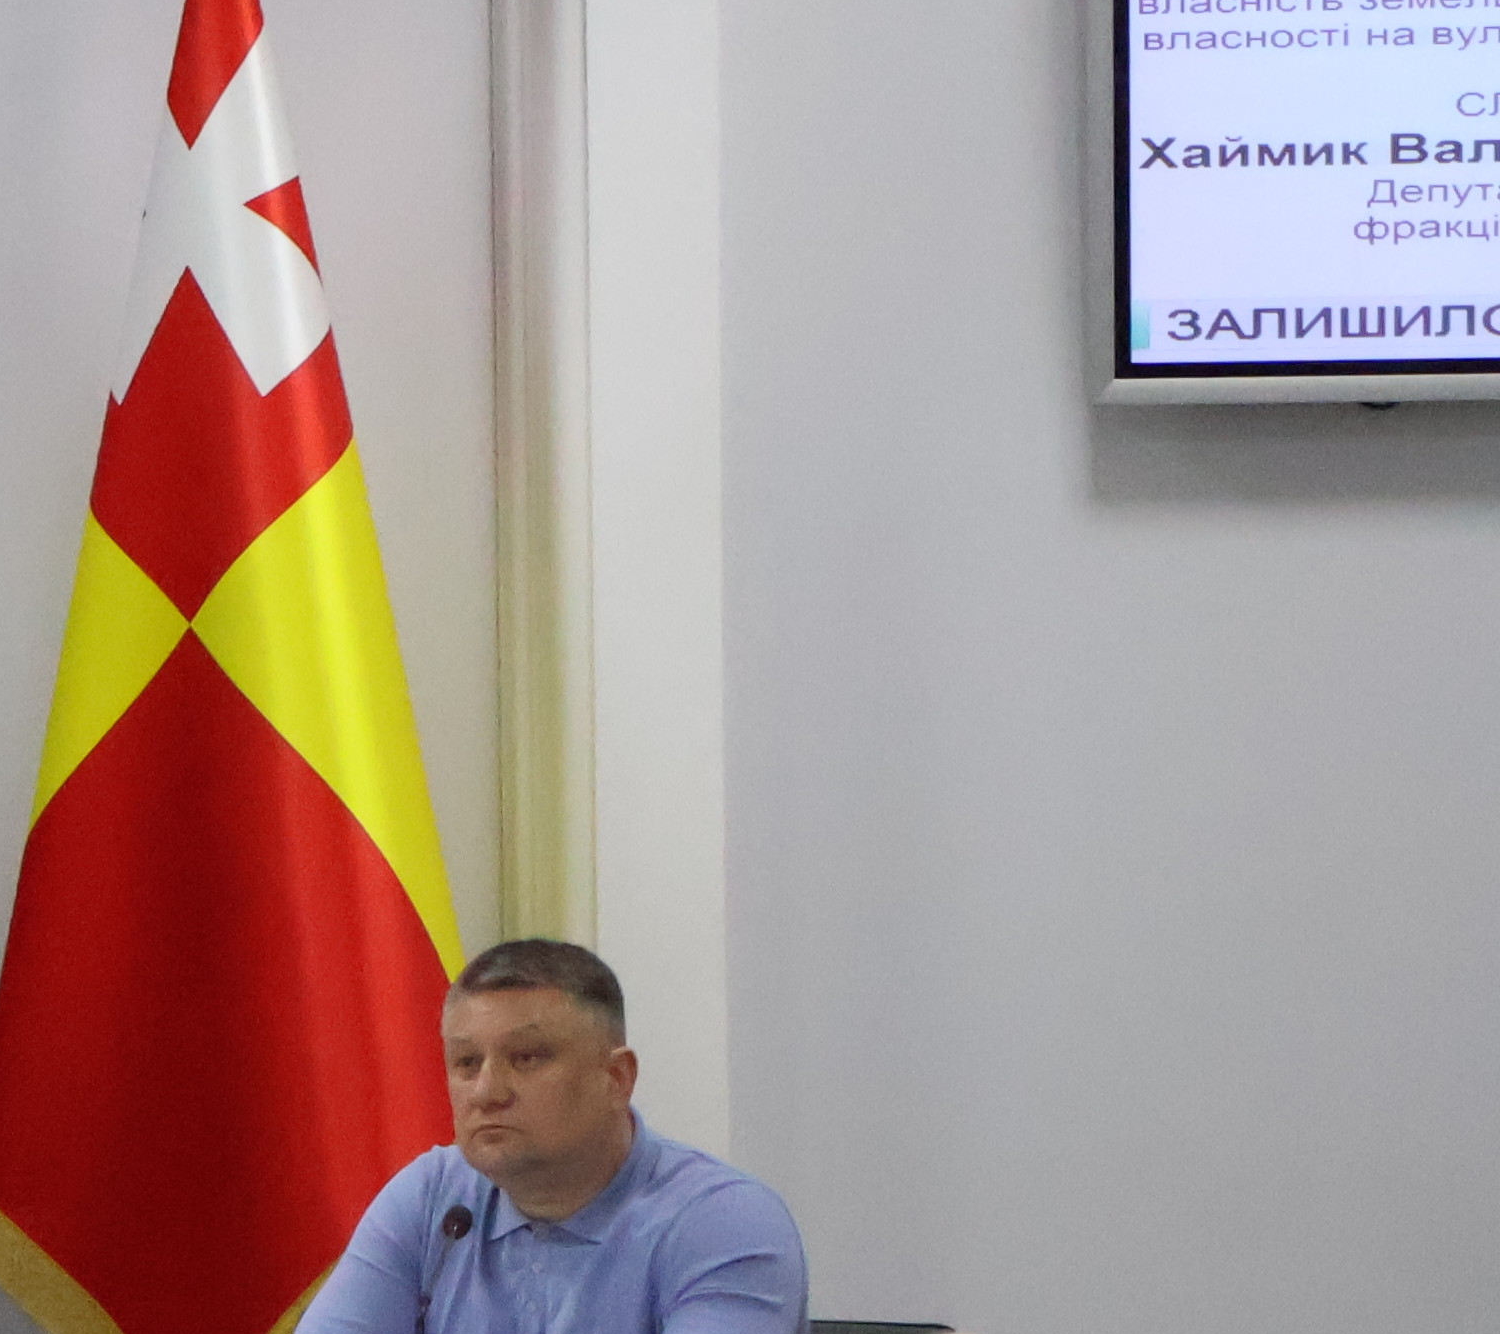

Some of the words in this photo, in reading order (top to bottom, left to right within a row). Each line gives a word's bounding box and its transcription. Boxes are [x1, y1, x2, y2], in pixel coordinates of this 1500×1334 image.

[1143, 22, 1351, 51] власності
[1366, 26, 1416, 47] на
[1432, 25, 1500, 51] вул
[1138, 135, 1369, 170] Хаймик
[1389, 132, 1500, 165] Вал
[1366, 178, 1500, 209] Депут
[1352, 214, 1500, 246] фракці
